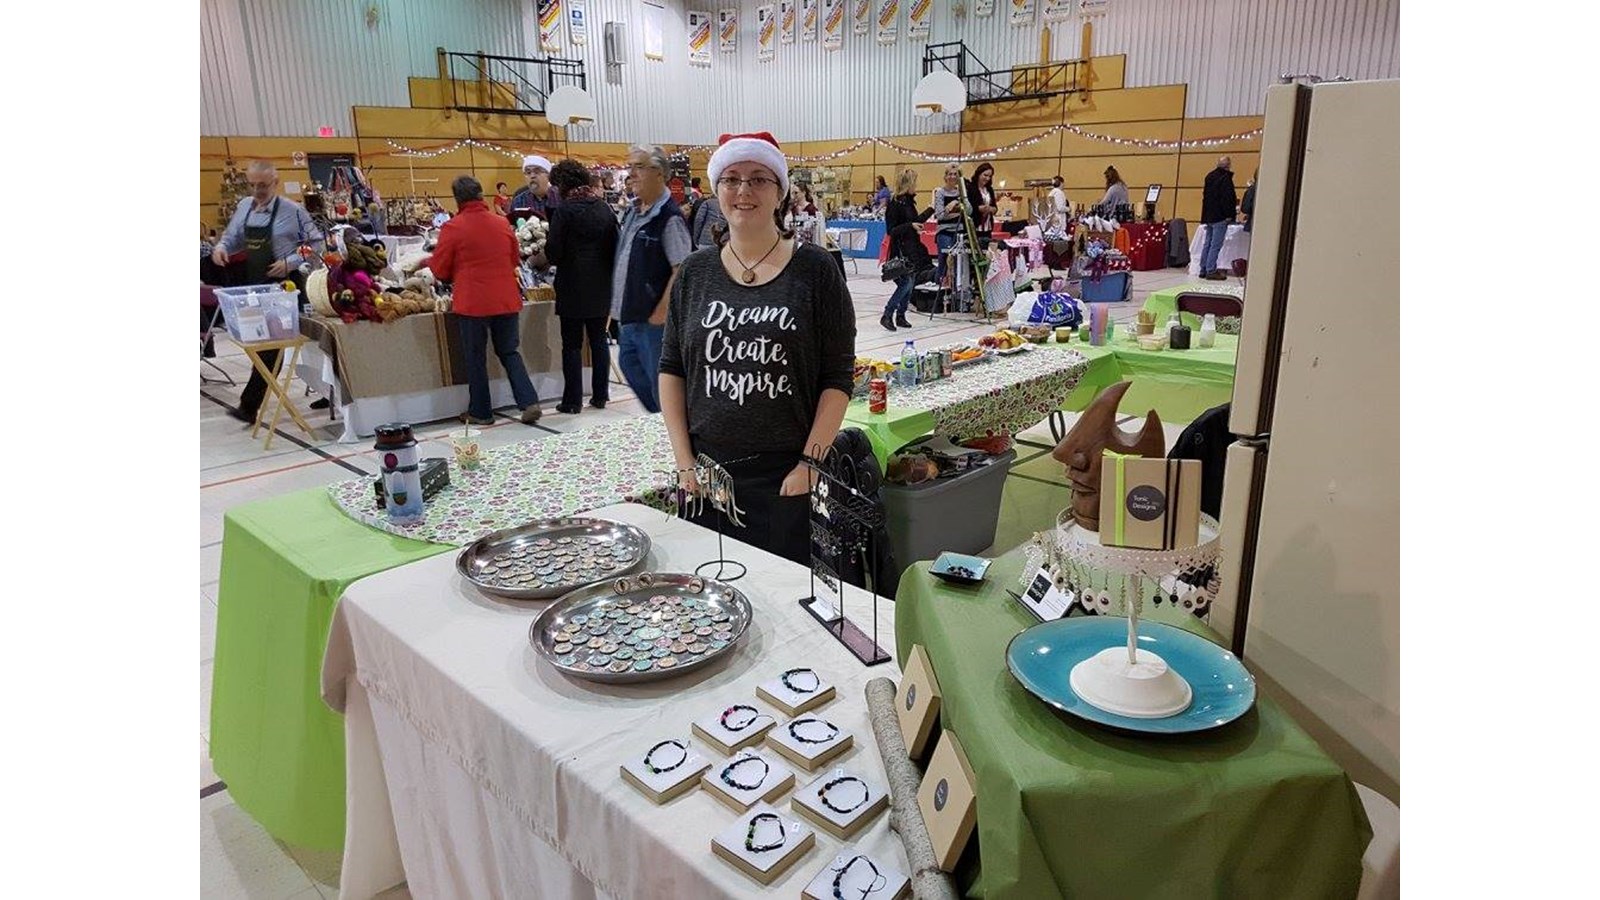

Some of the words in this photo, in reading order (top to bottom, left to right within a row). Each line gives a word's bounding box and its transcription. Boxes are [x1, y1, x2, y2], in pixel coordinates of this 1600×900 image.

[701, 300, 797, 331] Dream.
[705, 329, 788, 365] Create.
[704, 365, 792, 406] Inspire.
[1132, 503, 1157, 511] Designs
